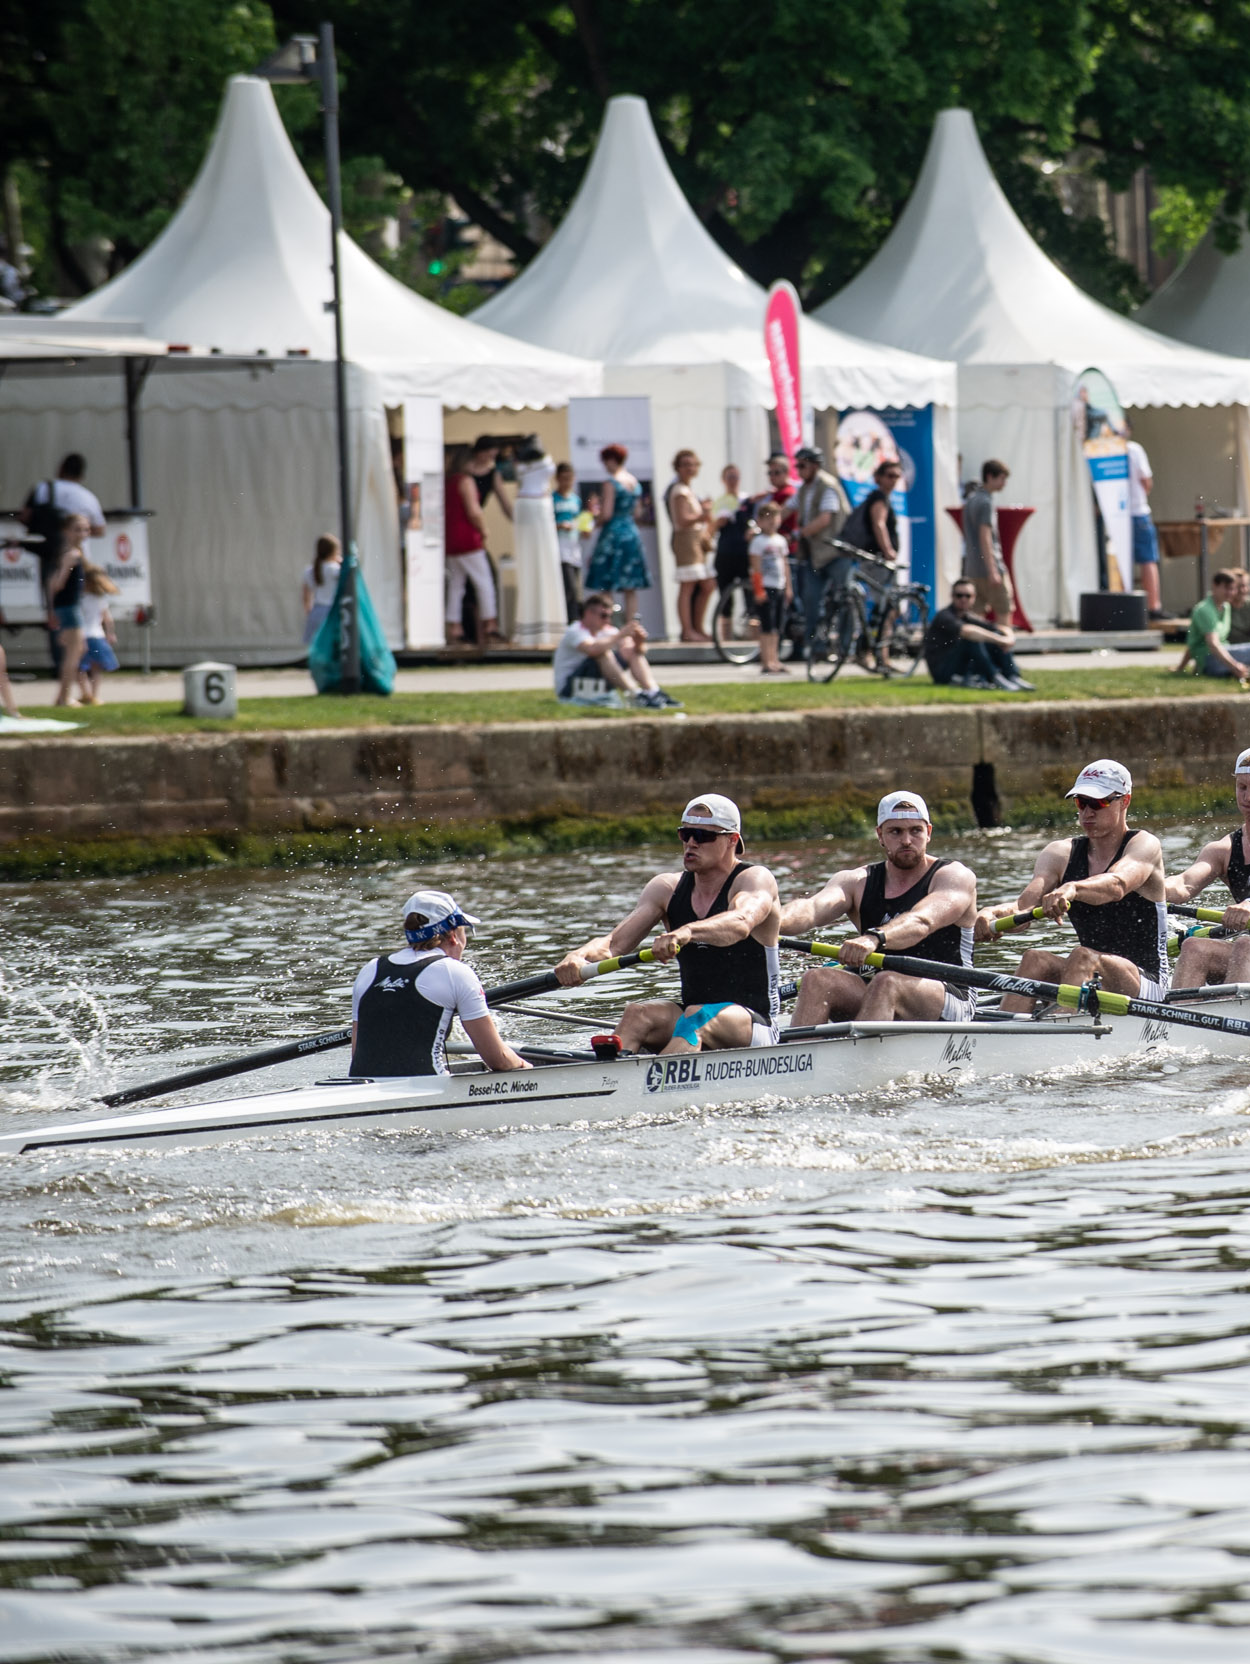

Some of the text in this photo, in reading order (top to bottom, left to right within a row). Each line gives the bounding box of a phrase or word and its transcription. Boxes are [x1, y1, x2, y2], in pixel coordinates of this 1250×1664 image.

[204, 672, 226, 705] 6
[780, 983, 796, 994] RBL
[1131, 1003, 1249, 1031] STARK. SCHNELL. GUT. RBL
[665, 1053, 813, 1084] RBL RUDER-BUNDESLIGA
[468, 1080, 538, 1097] Bessel-R.C. Minden
